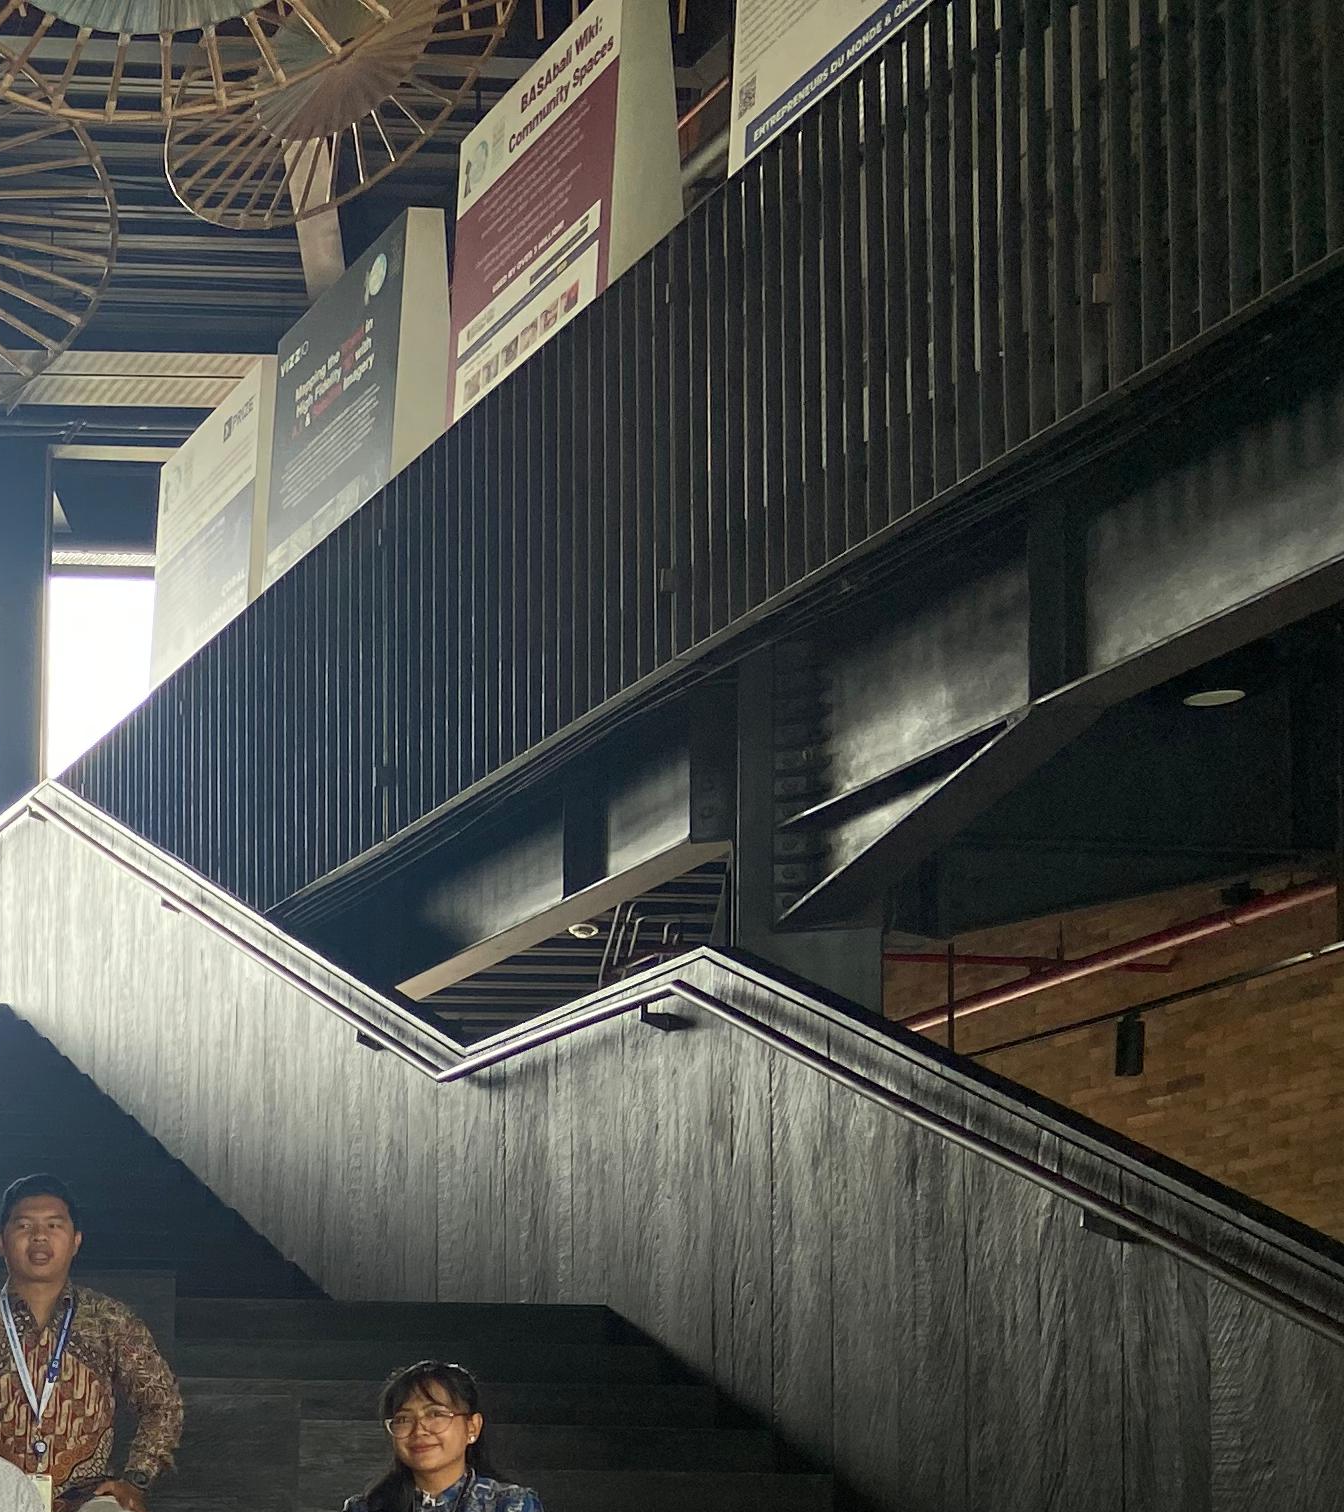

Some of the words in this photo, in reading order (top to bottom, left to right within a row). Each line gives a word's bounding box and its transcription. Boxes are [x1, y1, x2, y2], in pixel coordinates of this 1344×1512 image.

[508, 81, 571, 153] Community
[572, 35, 614, 88] Spaces
[520, 44, 573, 113] BASAbali
[575, 16, 604, 55] Wiki:
[752, 69, 829, 142] ENTREPRENEURS
[830, 56, 845, 74] DU
[846, 21, 883, 63] MONDE
[884, 12, 892, 27] &
